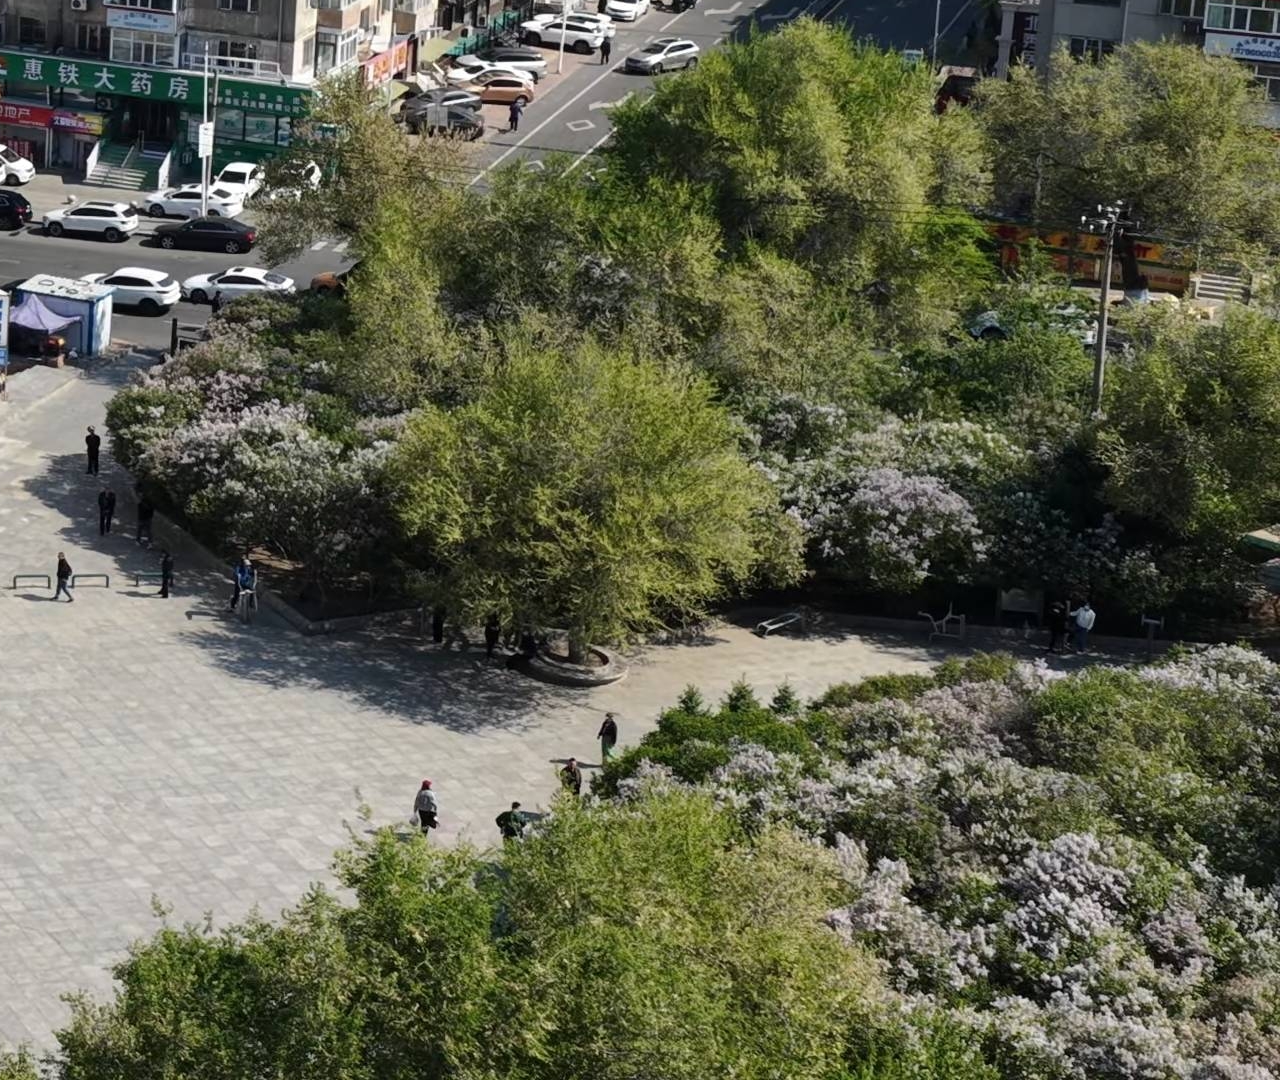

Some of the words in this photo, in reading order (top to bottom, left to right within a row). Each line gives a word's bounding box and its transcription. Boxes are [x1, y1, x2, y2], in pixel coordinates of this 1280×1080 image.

[23, 58, 189, 100] 惠铁大药房
